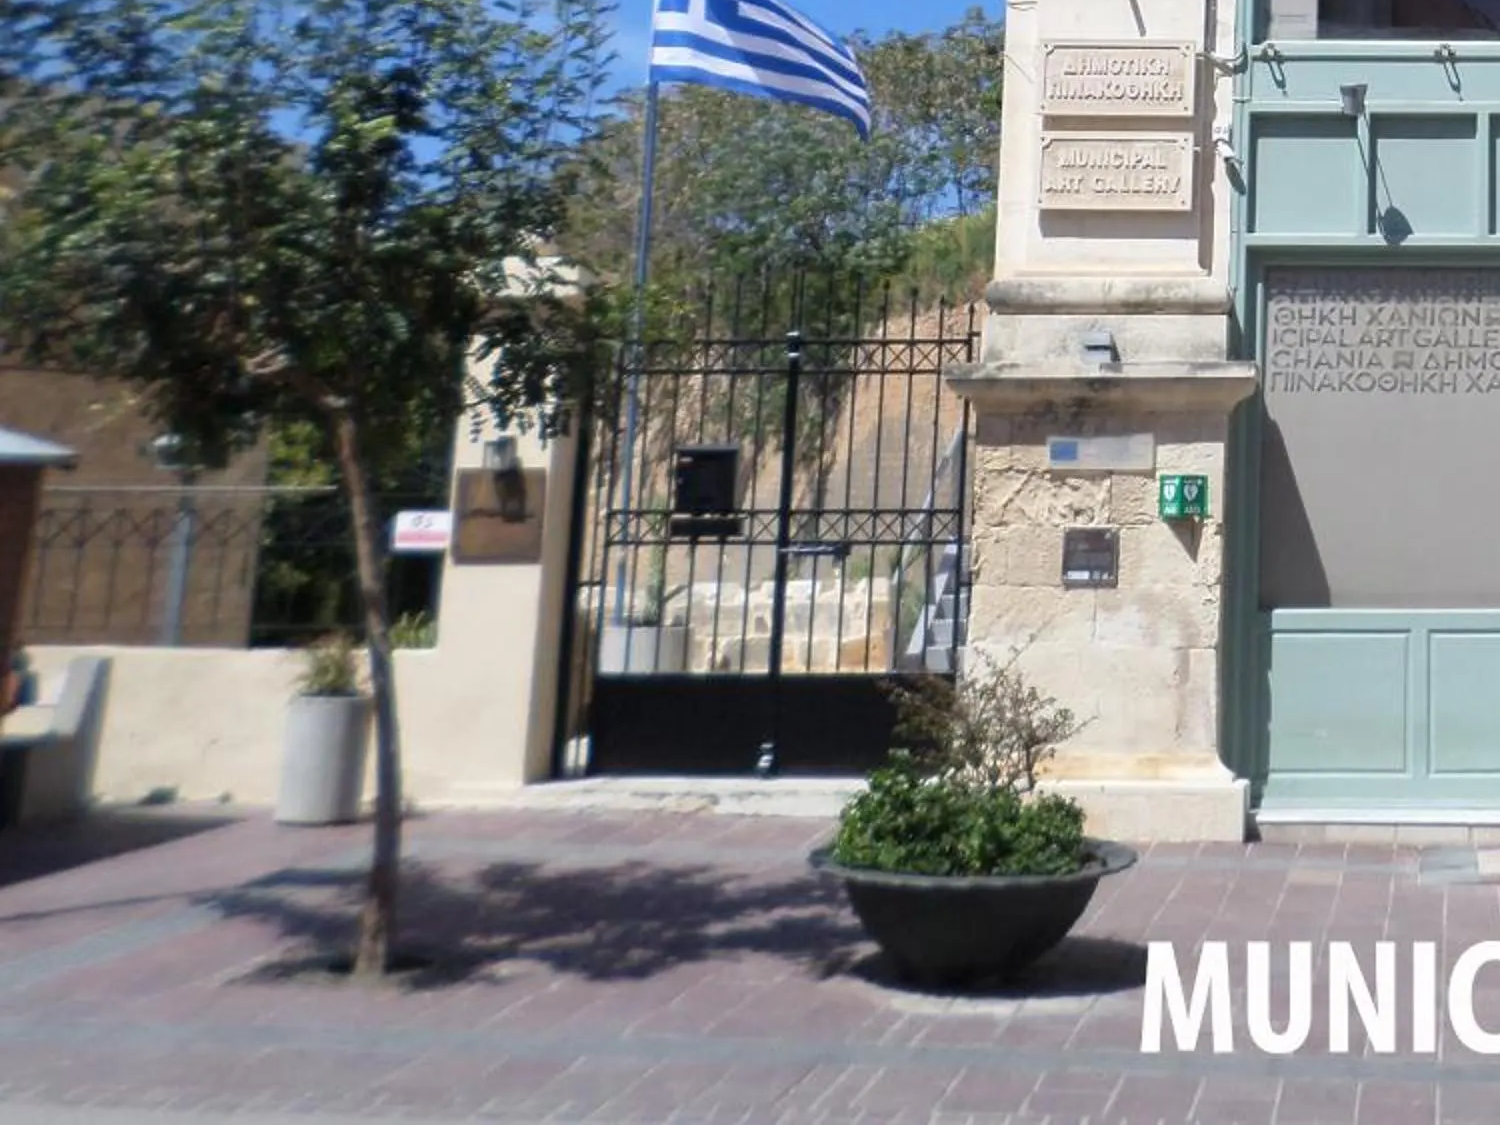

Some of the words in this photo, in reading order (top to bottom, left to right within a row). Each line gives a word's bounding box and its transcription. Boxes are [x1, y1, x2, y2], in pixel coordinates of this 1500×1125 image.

[1062, 57, 1171, 76] ΔΗΜΟΤΙΚΗ
[1057, 149, 1168, 169] MUNICIPAL
[1044, 177, 1083, 194] ART
[1094, 177, 1181, 195] GALLERY
[1359, 328, 1413, 349] ART
[1271, 350, 1384, 371] CHANIA
